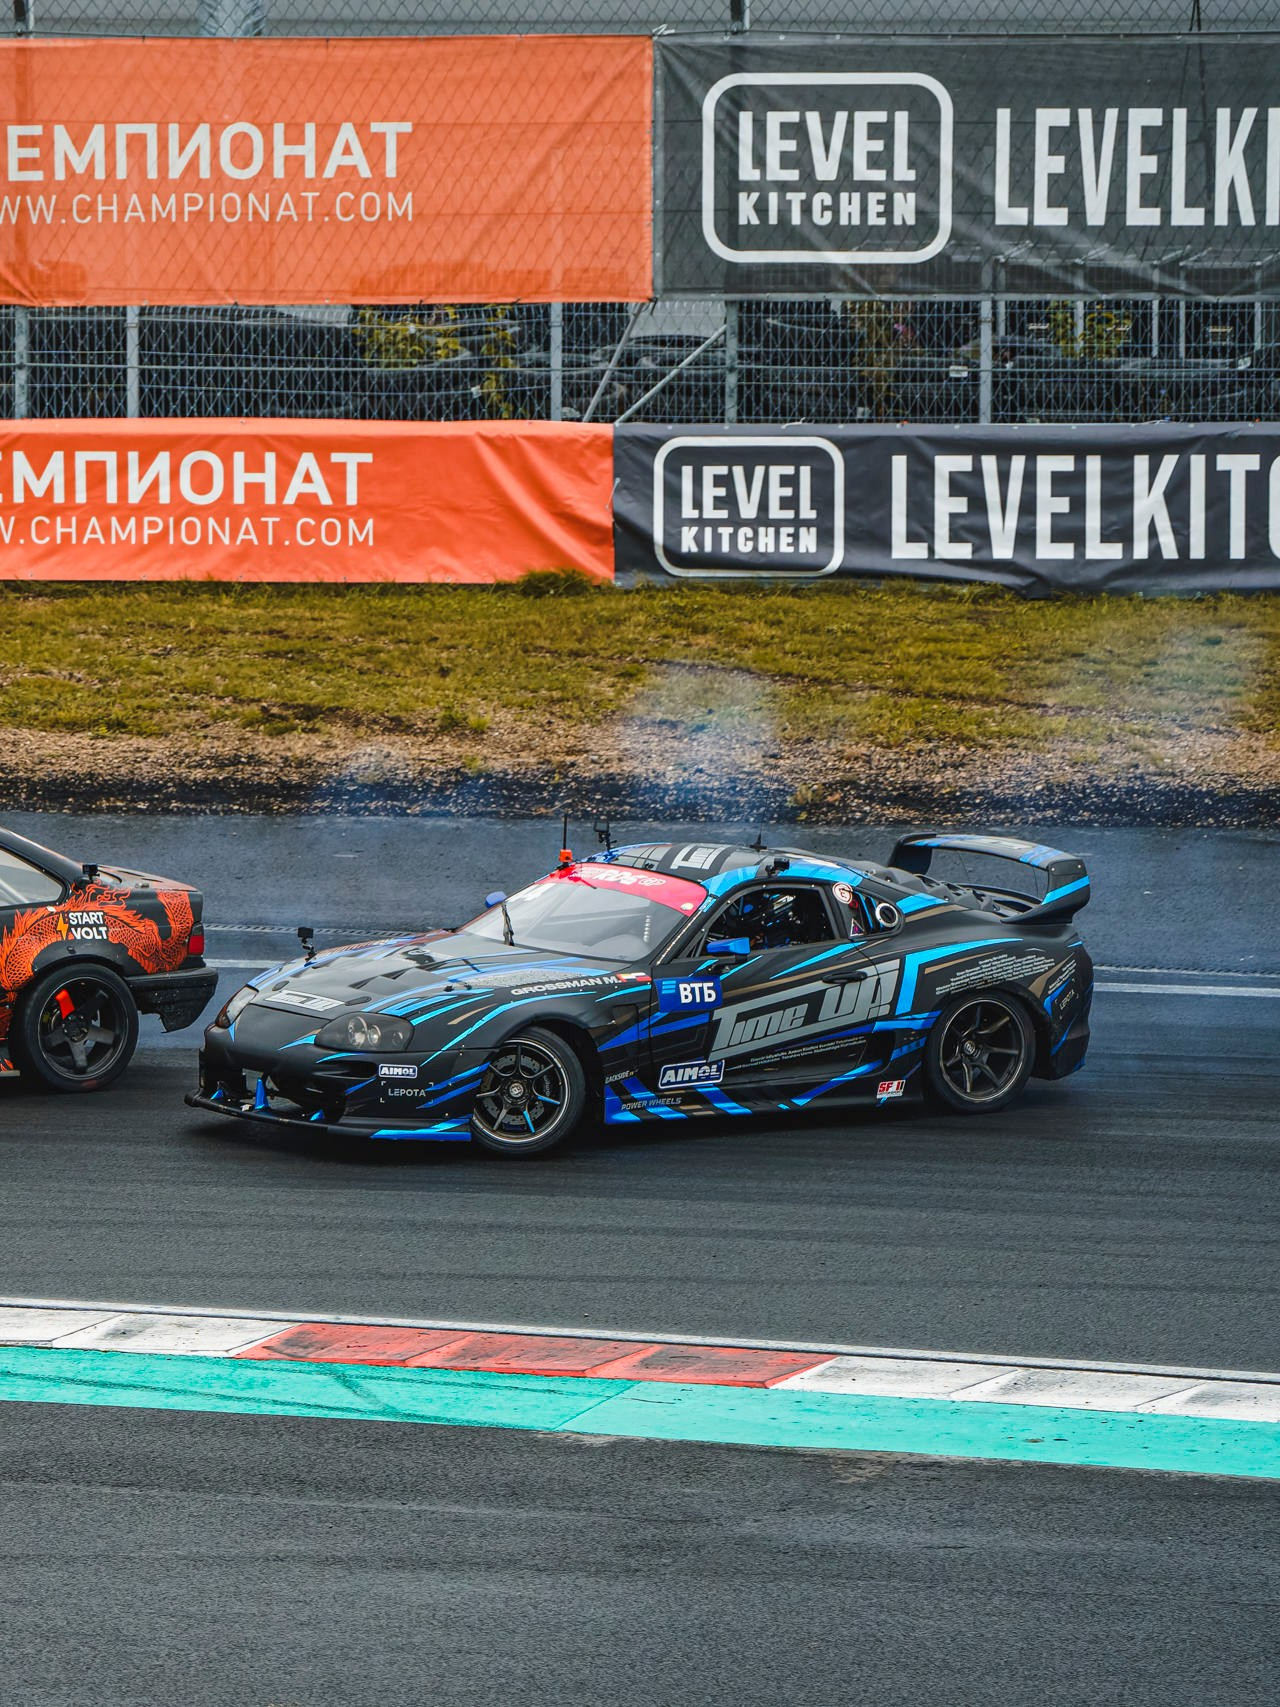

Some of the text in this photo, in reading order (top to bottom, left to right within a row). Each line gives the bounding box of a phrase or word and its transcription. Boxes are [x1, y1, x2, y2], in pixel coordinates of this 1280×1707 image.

[738, 110, 916, 182] LEVEL
[995, 107, 1280, 226] LEVELKI
[738, 192, 916, 226] KITCHEN
[681, 465, 816, 519] LEVEL
[681, 526, 817, 554] KITCHEN
[69, 912, 103, 925] START
[71, 927, 107, 939] VOLT
[511, 977, 602, 995] GROSSMAN
[679, 982, 717, 1004] ВТБ
[381, 1066, 416, 1077] AIMOL
[662, 1064, 720, 1083] AIMOL
[388, 1088, 426, 1097] LEPOTA
[648, 1097, 683, 1107] WHEELS
